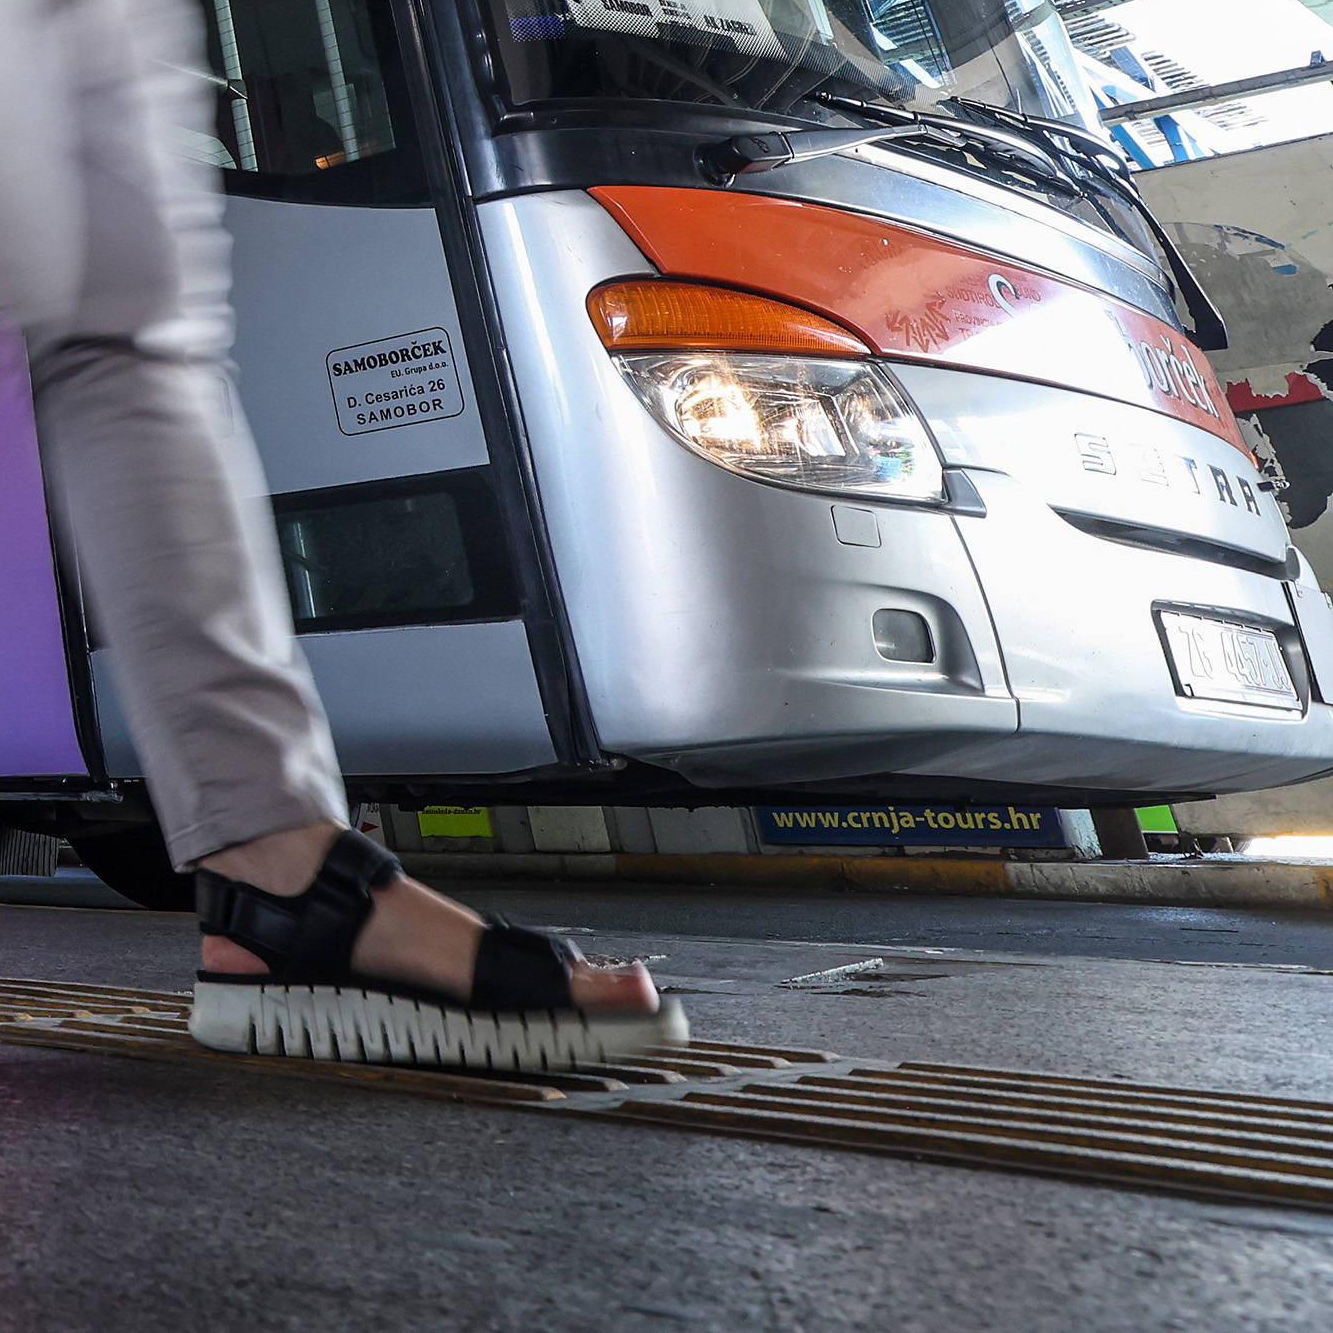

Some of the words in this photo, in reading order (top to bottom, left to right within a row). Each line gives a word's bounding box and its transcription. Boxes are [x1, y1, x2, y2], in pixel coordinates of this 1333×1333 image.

[332, 339, 447, 377] SAMOBORČEK
[390, 369, 404, 379] EU.
[404, 365, 428, 375] Grupa
[428, 361, 449, 370] d.o.o.
[347, 396, 362, 409] D.
[365, 383, 425, 405] Cesarića
[428, 378, 446, 392] 26
[356, 398, 444, 425] SAMOBOR
[1074, 432, 1261, 516] SETRA
[772, 806, 1042, 834] www.crnja-tours.hr
